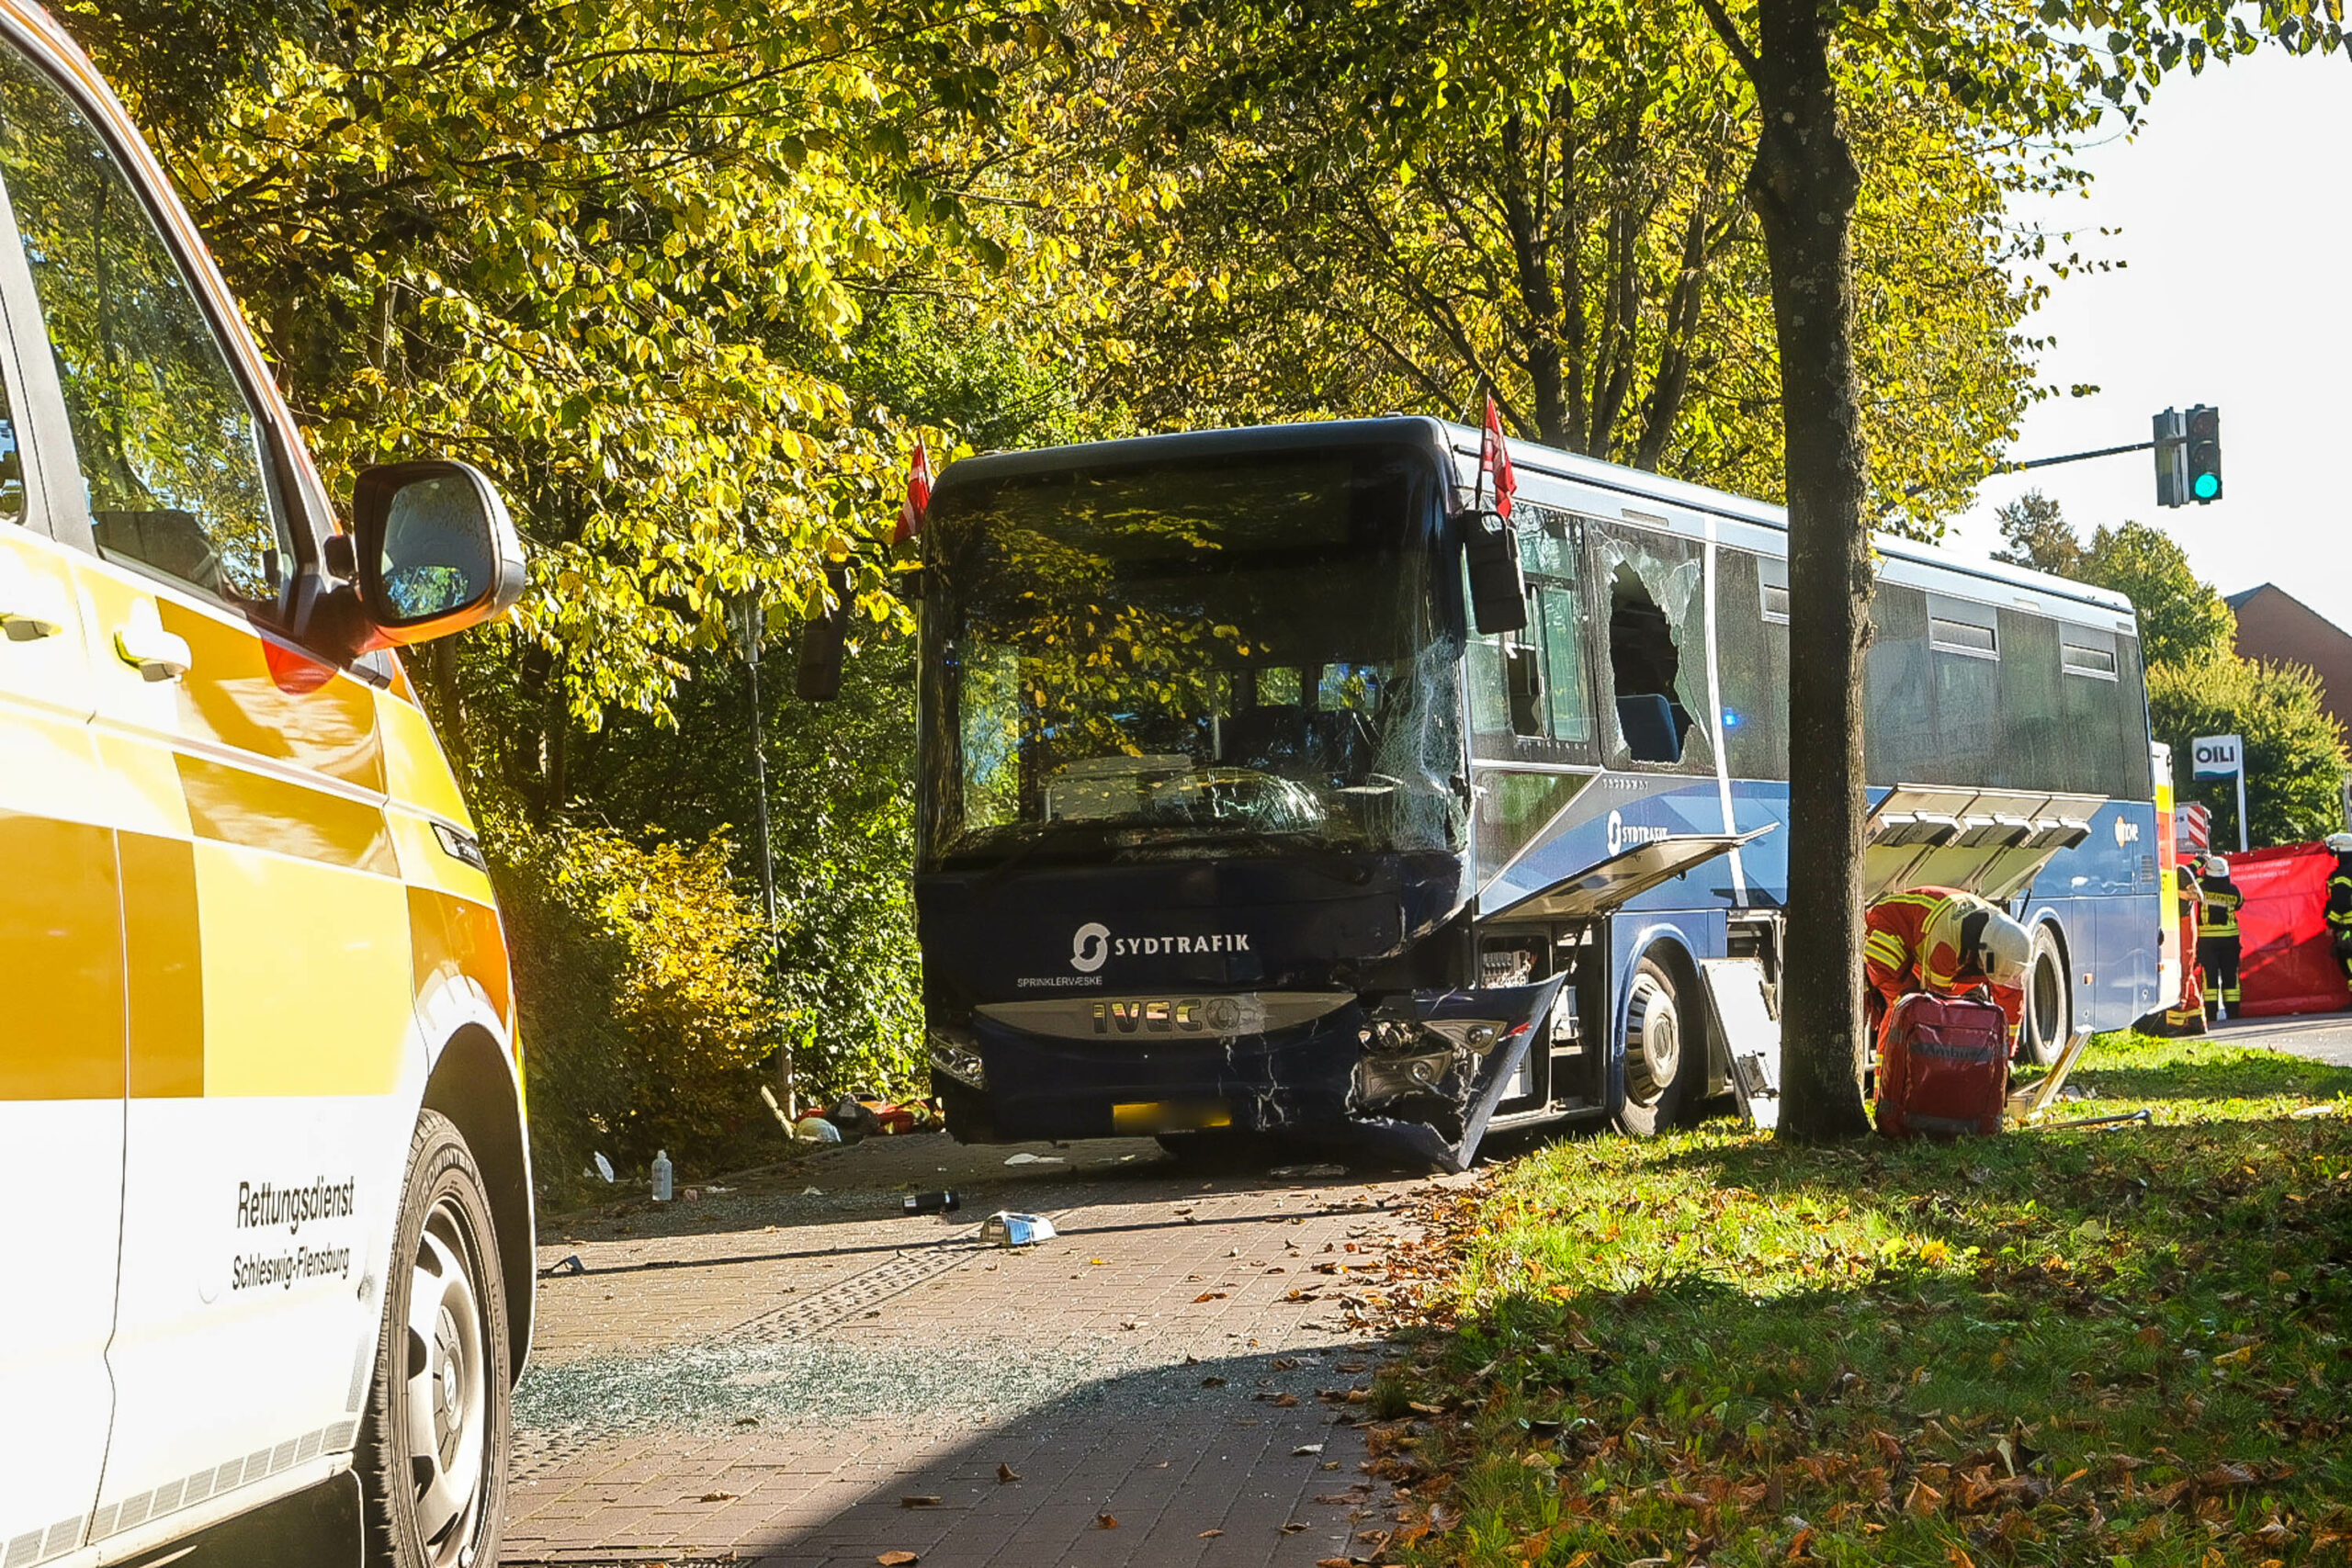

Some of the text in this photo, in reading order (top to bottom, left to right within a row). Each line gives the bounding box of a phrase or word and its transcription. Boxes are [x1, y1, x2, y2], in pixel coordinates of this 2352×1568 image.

[2196, 746, 2234, 763] OILI
[1114, 934, 1250, 956] SYDTRAFIK
[1017, 976, 1102, 987] SPRINKLERVÆSKE
[1092, 998, 1240, 1034] IVECO
[237, 1175, 354, 1235] Rettungsdienst
[232, 1242, 350, 1290] Schleswig-Flensburg
